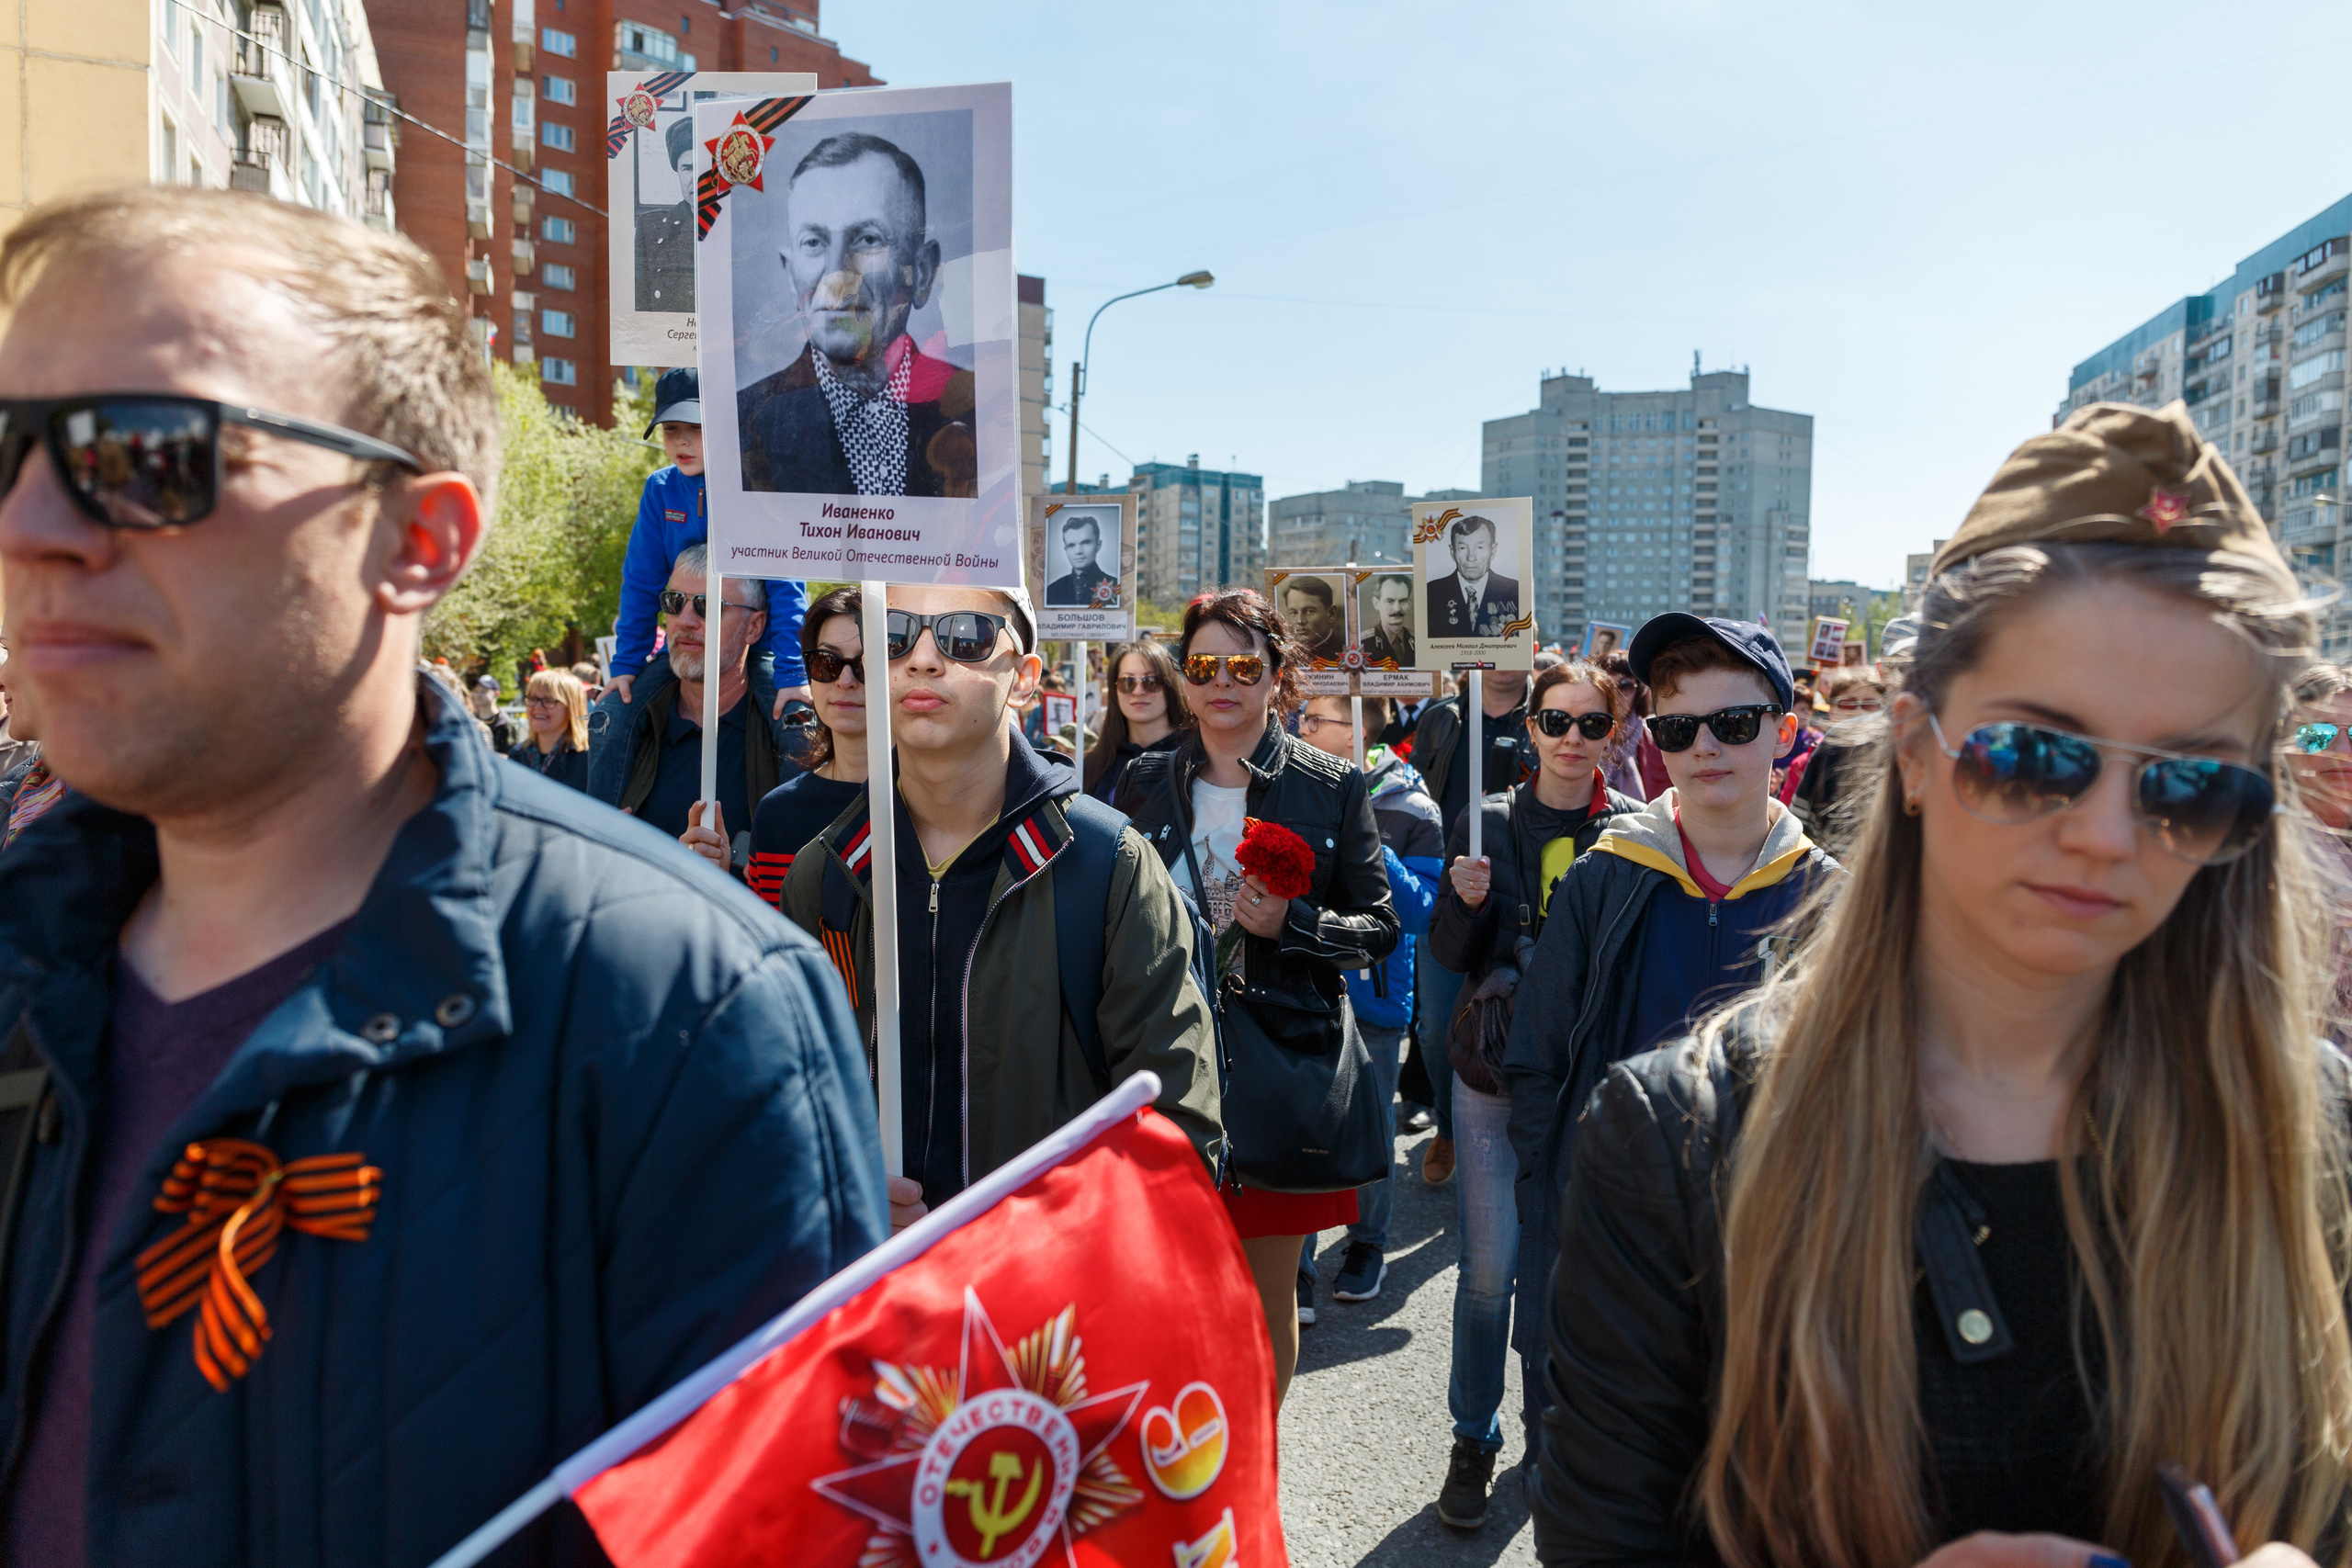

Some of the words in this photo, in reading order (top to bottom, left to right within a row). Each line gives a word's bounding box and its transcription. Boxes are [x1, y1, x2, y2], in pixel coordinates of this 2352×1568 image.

[821, 502, 895, 520] Иваненко
[799, 522, 842, 538] Тихон
[846, 524, 921, 541] Иванович
[731, 546, 788, 559] участник
[792, 547, 842, 561] Великой
[846, 548, 951, 567] Отечественной
[956, 553, 999, 568] Войны
